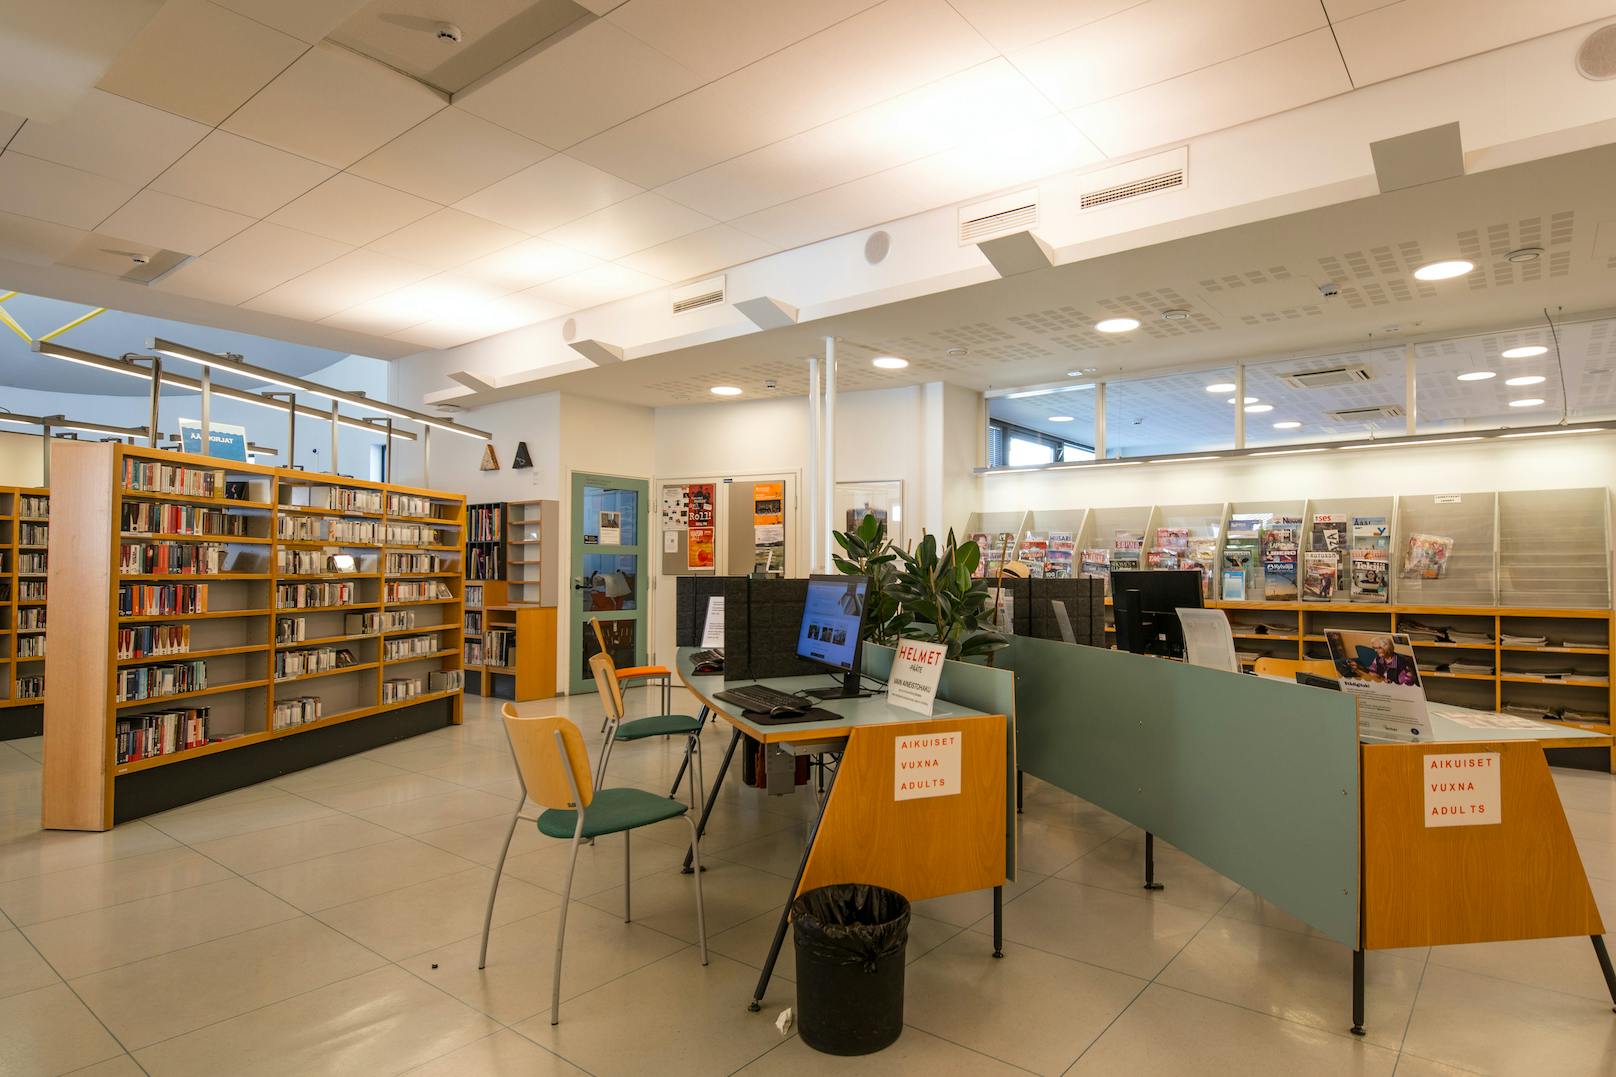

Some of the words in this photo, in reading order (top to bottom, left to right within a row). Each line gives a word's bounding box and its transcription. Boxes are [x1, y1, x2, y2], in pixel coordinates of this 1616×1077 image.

[899, 645, 942, 666] HELMET
[901, 737, 956, 749] AIKUISET
[901, 759, 939, 770] VUXNA
[1430, 758, 1493, 770] AIKUISET
[901, 778, 946, 791] ADULTS
[1431, 782, 1475, 793] VUXNA
[1431, 804, 1486, 816] ADULTS
